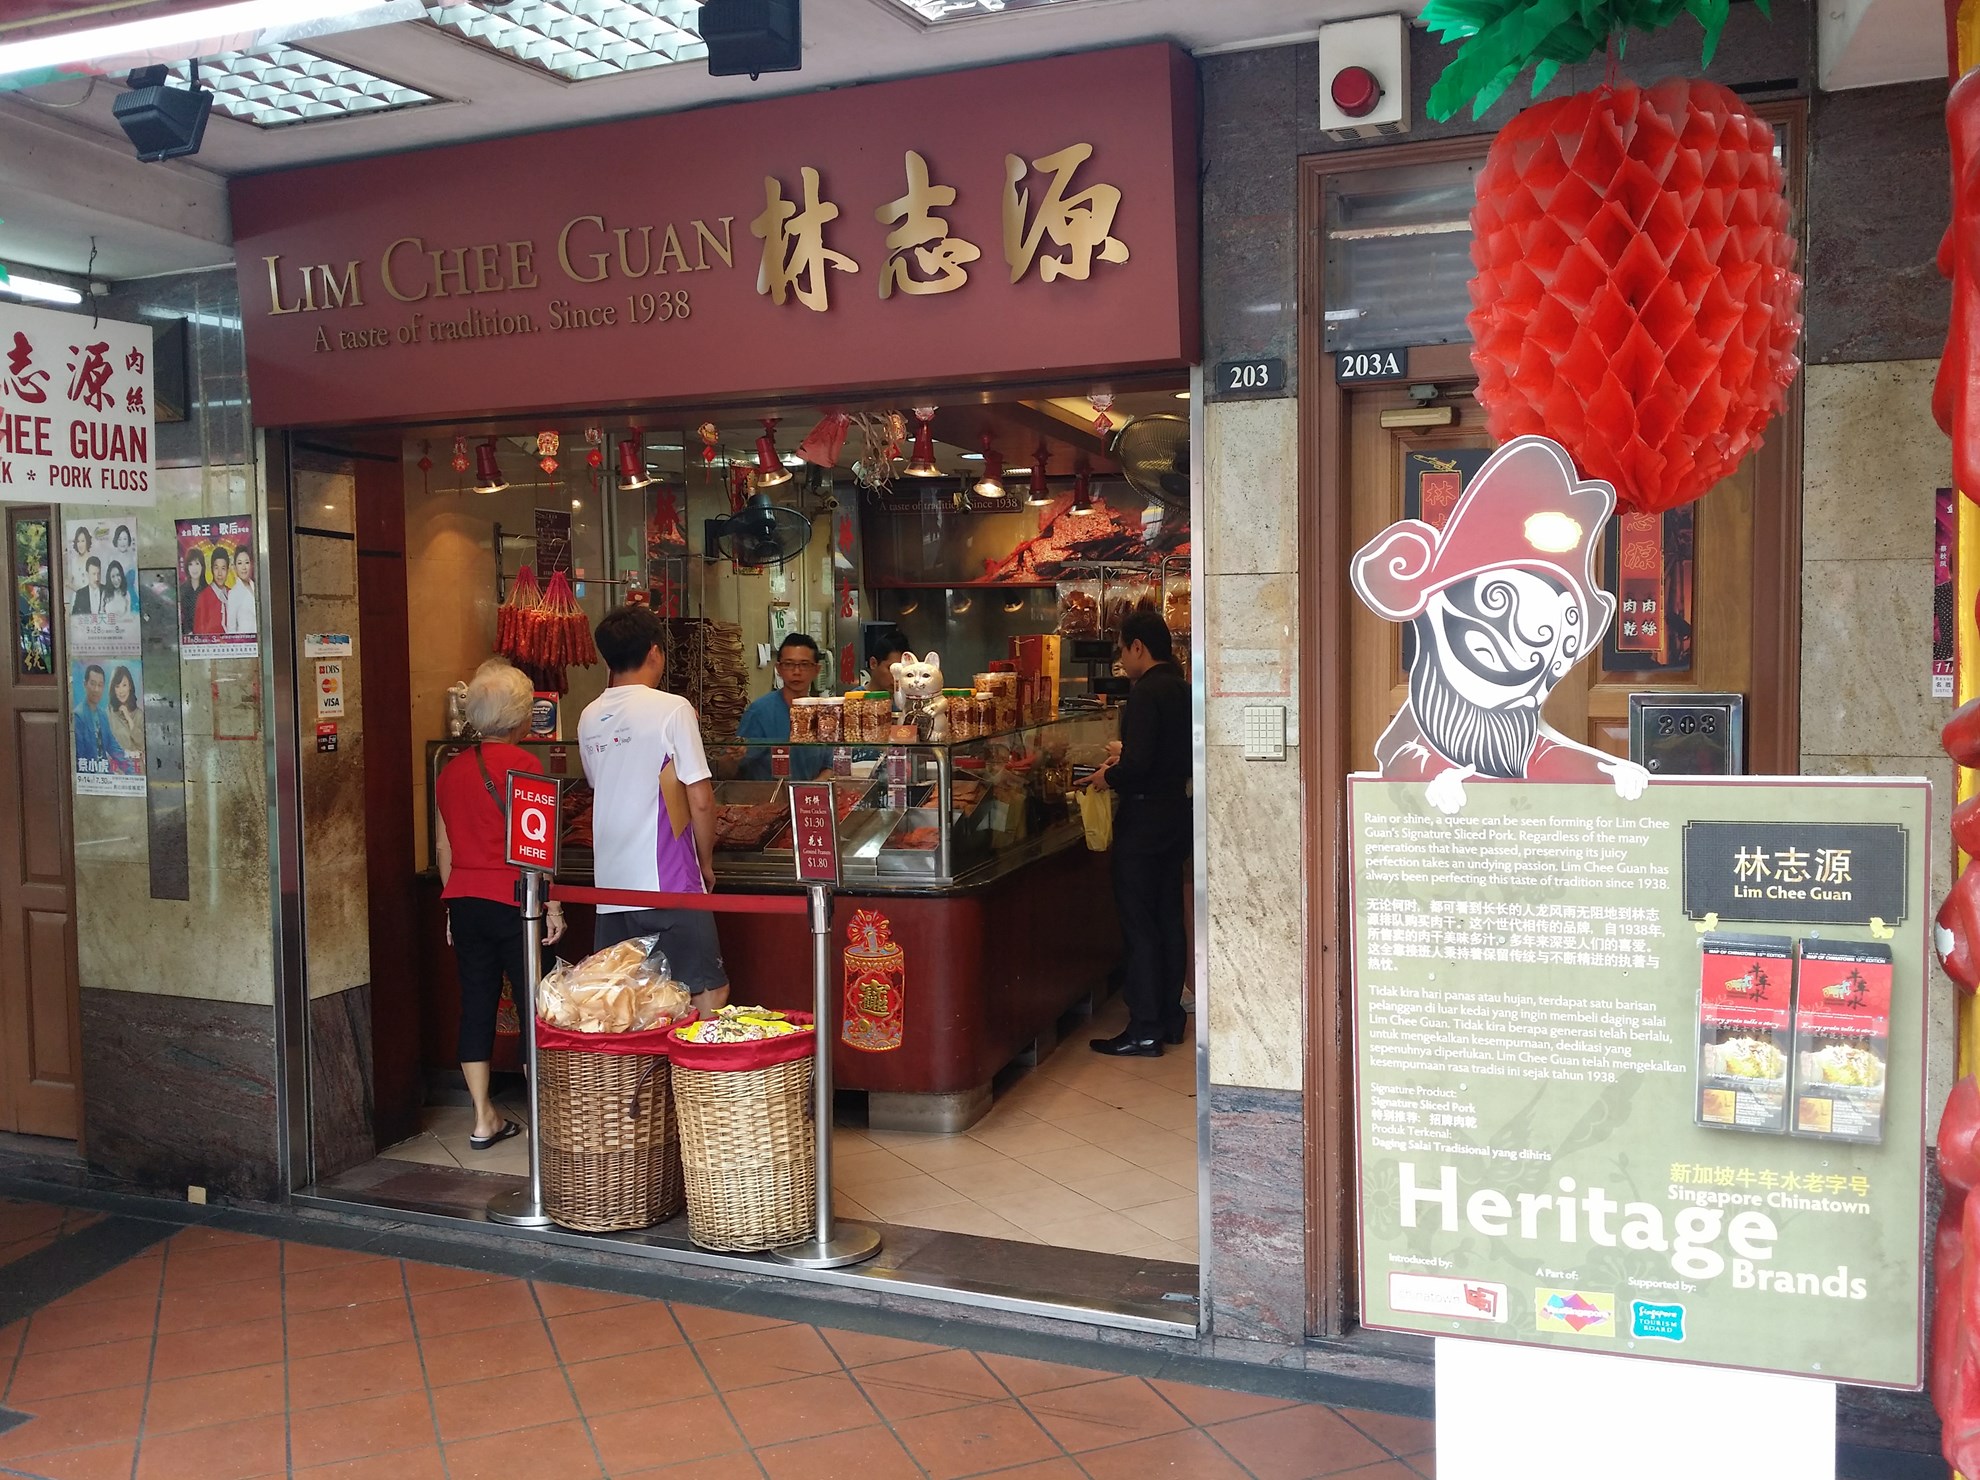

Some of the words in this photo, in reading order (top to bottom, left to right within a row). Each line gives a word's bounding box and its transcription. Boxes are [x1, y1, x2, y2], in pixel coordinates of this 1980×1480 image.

[750, 142, 1130, 313] 林志源
[262, 254, 364, 316] LIM
[381, 237, 540, 303] CHEE
[557, 215, 736, 283] GUAN
[312, 324, 331, 353] A
[340, 326, 389, 350] taste
[396, 313, 423, 344] of
[429, 305, 541, 342] tradition.
[548, 300, 617, 331] Since
[627, 289, 691, 325] 1938
[3, 331, 115, 413] 志源
[1341, 352, 1401, 378] 203A
[1230, 364, 1269, 389] 203
[70, 419, 147, 464] GUAN
[49, 464, 92, 488] PORK
[101, 467, 148, 492] FLOSS
[889, 501, 910, 511] taste
[996, 498, 1018, 508] 1938
[775, 611, 785, 629] 16
[325, 664, 340, 674] DBS
[323, 697, 340, 707] VISA
[1657, 714, 1717, 736] 203
[514, 788, 555, 807] PLEASE
[520, 807, 548, 843] Q
[804, 816, 825, 828] $1.30
[1364, 813, 1387, 823] Rain
[1388, 816, 1401, 824] or
[1402, 814, 1433, 826] shine,
[1444, 817, 1479, 827] queue
[1481, 817, 1500, 825] can
[1503, 815, 1518, 826] be
[1520, 818, 1546, 826] seen
[1548, 816, 1593, 829] forming
[1595, 817, 1613, 827] for
[1615, 817, 1636, 828] Lim
[1638, 818, 1669, 828] Chee
[808, 834, 823, 847] 花生
[1401, 828, 1451, 841] Signature
[1454, 829, 1486, 840] Sliced
[1488, 830, 1516, 841] Pork.
[1519, 831, 1579, 843] Regardless
[1581, 832, 1594, 842] of
[1596, 832, 1615, 843] the
[1618, 835, 1649, 846] many
[518, 844, 547, 860] HERE
[1364, 843, 1426, 855] generations
[1428, 844, 1449, 854] that
[1451, 844, 1477, 855] have
[1479, 845, 1521, 857] passed,
[1523, 847, 1583, 859] preserving
[1585, 847, 1598, 857] its
[1599, 847, 1627, 860] juicy
[808, 857, 828, 868] $1.80
[1364, 857, 1419, 869] perfection
[1421, 858, 1449, 869] takes
[1451, 861, 1464, 869] an
[1467, 860, 1512, 873] undying
[1513, 861, 1558, 873] passion.
[1561, 862, 1581, 872] Lim
[1583, 862, 1614, 873] Chee
[1616, 863, 1646, 874] Guan
[1649, 864, 1669, 874] has
[1734, 846, 1852, 884] 林志源
[1365, 871, 1399, 884] always
[1401, 872, 1428, 882] been
[1430, 873, 1486, 886] perfecting
[1488, 874, 1508, 884] this
[1510, 876, 1537, 885] taste
[1539, 875, 1551, 885] of
[1553, 876, 1603, 887] tradition
[1605, 877, 1634, 887] since
[1637, 878, 1669, 888] 1938.
[1734, 885, 1762, 899] Lim
[1766, 886, 1807, 901] Chee
[1811, 886, 1852, 902] Guan
[1369, 1030, 1399, 1040] untuk
[1400, 1033, 1469, 1044] mengekalkan
[1471, 1035, 1553, 1051] kesempurnaan,
[1555, 1040, 1601, 1052] dedikasi
[1604, 1045, 1631, 1056] yang
[1369, 1045, 1432, 1059] sepenuhnya
[1434, 1047, 1494, 1060] diperlukan.
[1496, 1051, 1516, 1061] Lim
[1518, 1052, 1547, 1063] Chee
[1549, 1054, 1579, 1065] Guan
[1581, 1056, 1609, 1067] telah
[1612, 1060, 1686, 1072] mengekalkan
[1370, 1097, 1418, 1110] Signature
[1419, 1100, 1449, 1111] Sliced
[1451, 1102, 1475, 1113] Pork
[1371, 1123, 1405, 1135] Produk
[1670, 1162, 1870, 1197] 新加坡牛车水老字号
[1668, 1184, 1763, 1207] Singapore
[1767, 1192, 1870, 1215] Chinatown
[1399, 1161, 1778, 1280] Heritage
[1389, 1253, 1436, 1267] Introduced
[1437, 1257, 1453, 1269] by:
[1535, 1268, 1543, 1277] A
[1545, 1269, 1564, 1280] Part
[1565, 1270, 1579, 1280] of:
[1732, 1258, 1867, 1300] Brands
[1628, 1277, 1675, 1292] Supported
[1678, 1281, 1697, 1293] by:
[1638, 1305, 1677, 1319] Singapore
[1639, 1318, 1677, 1328] TOURISM
[1643, 1325, 1673, 1334] BOARD
